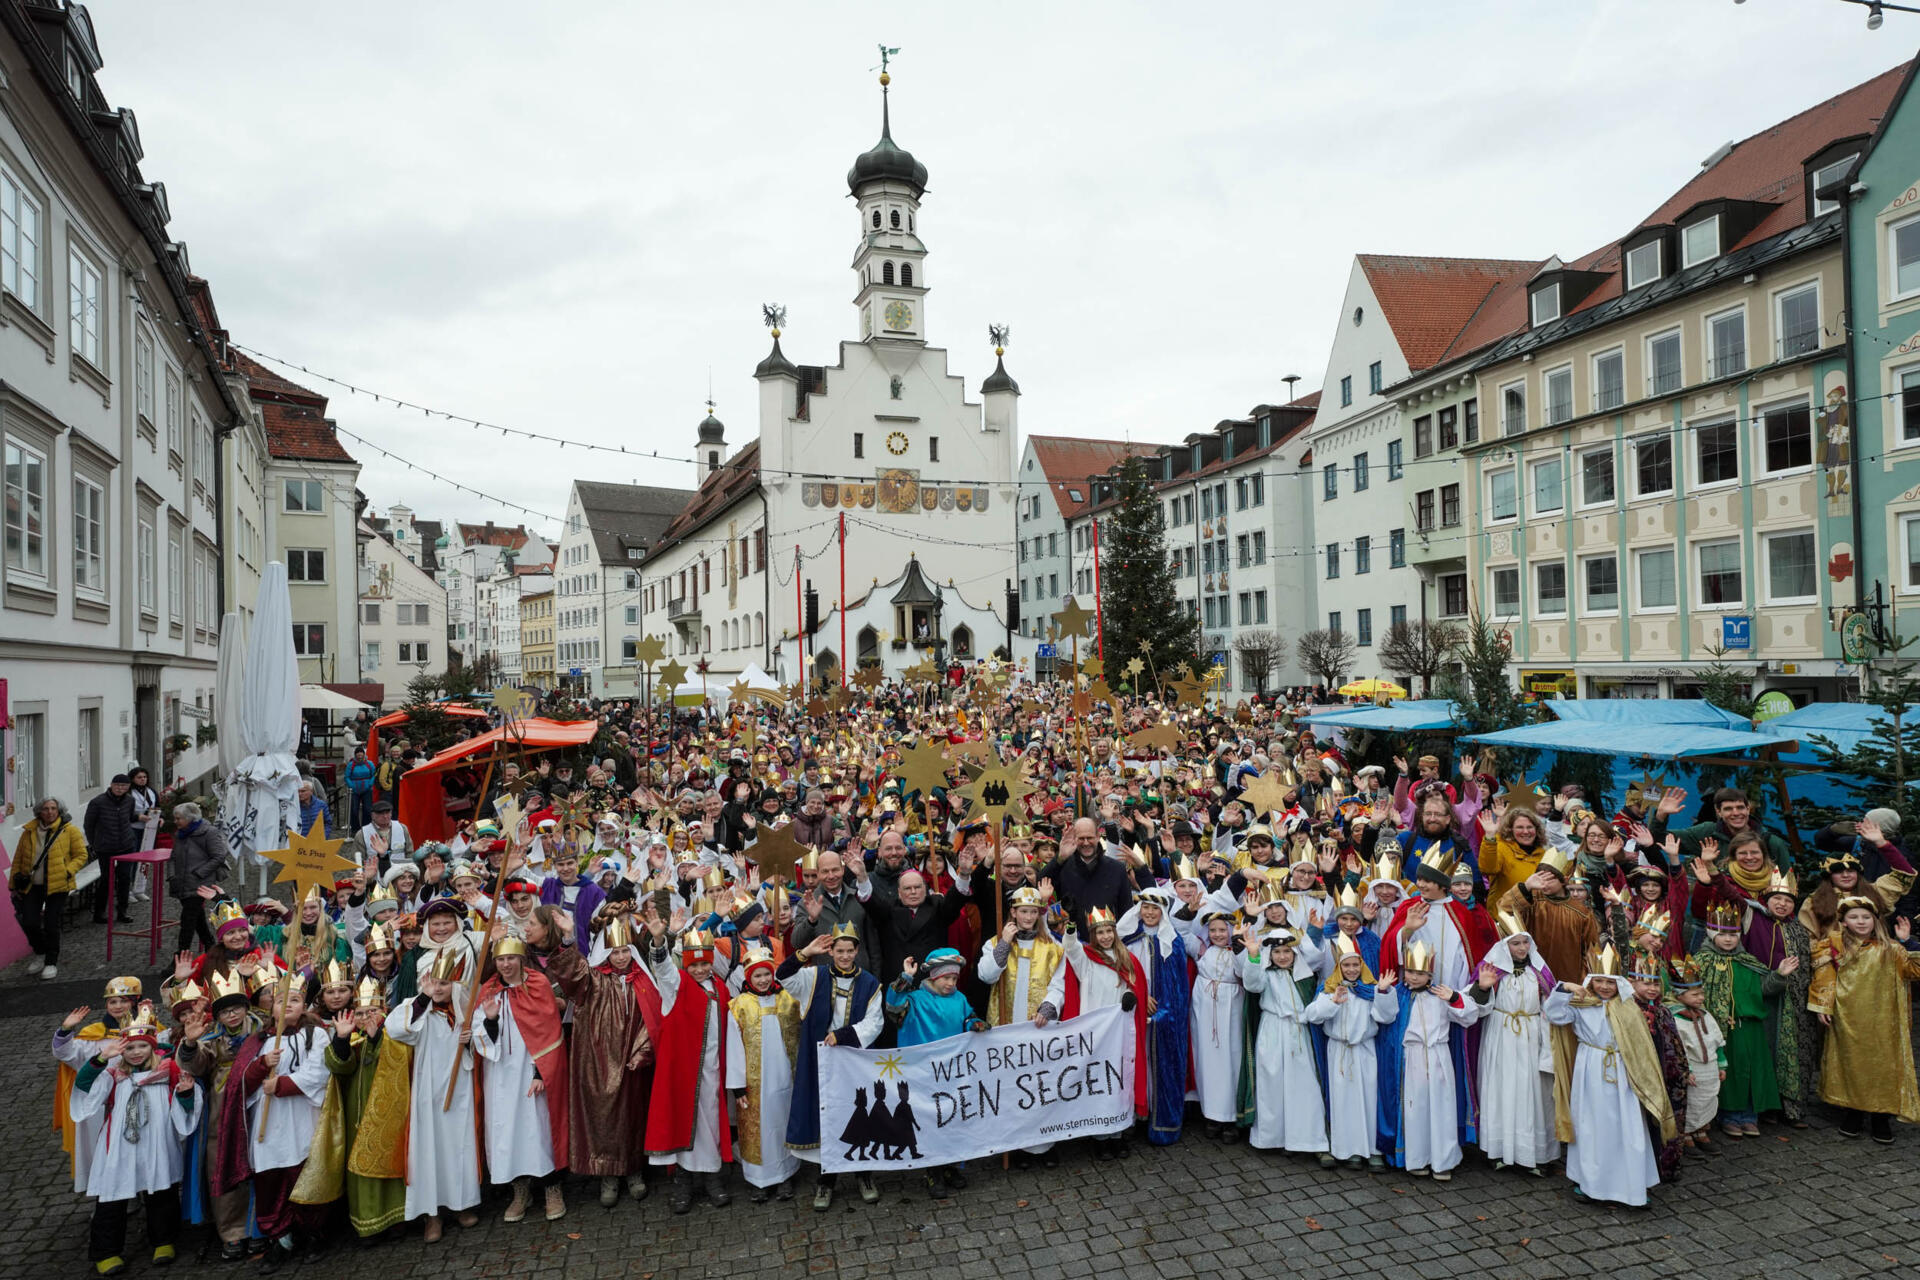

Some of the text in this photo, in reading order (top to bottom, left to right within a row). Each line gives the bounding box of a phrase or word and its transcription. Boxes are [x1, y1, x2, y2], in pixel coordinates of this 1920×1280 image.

[931, 1031, 1093, 1083] WIR BRINGEN
[931, 1056, 1124, 1128] DEN SEGEN
[1039, 1111, 1129, 1135] www.sternsinger.de
